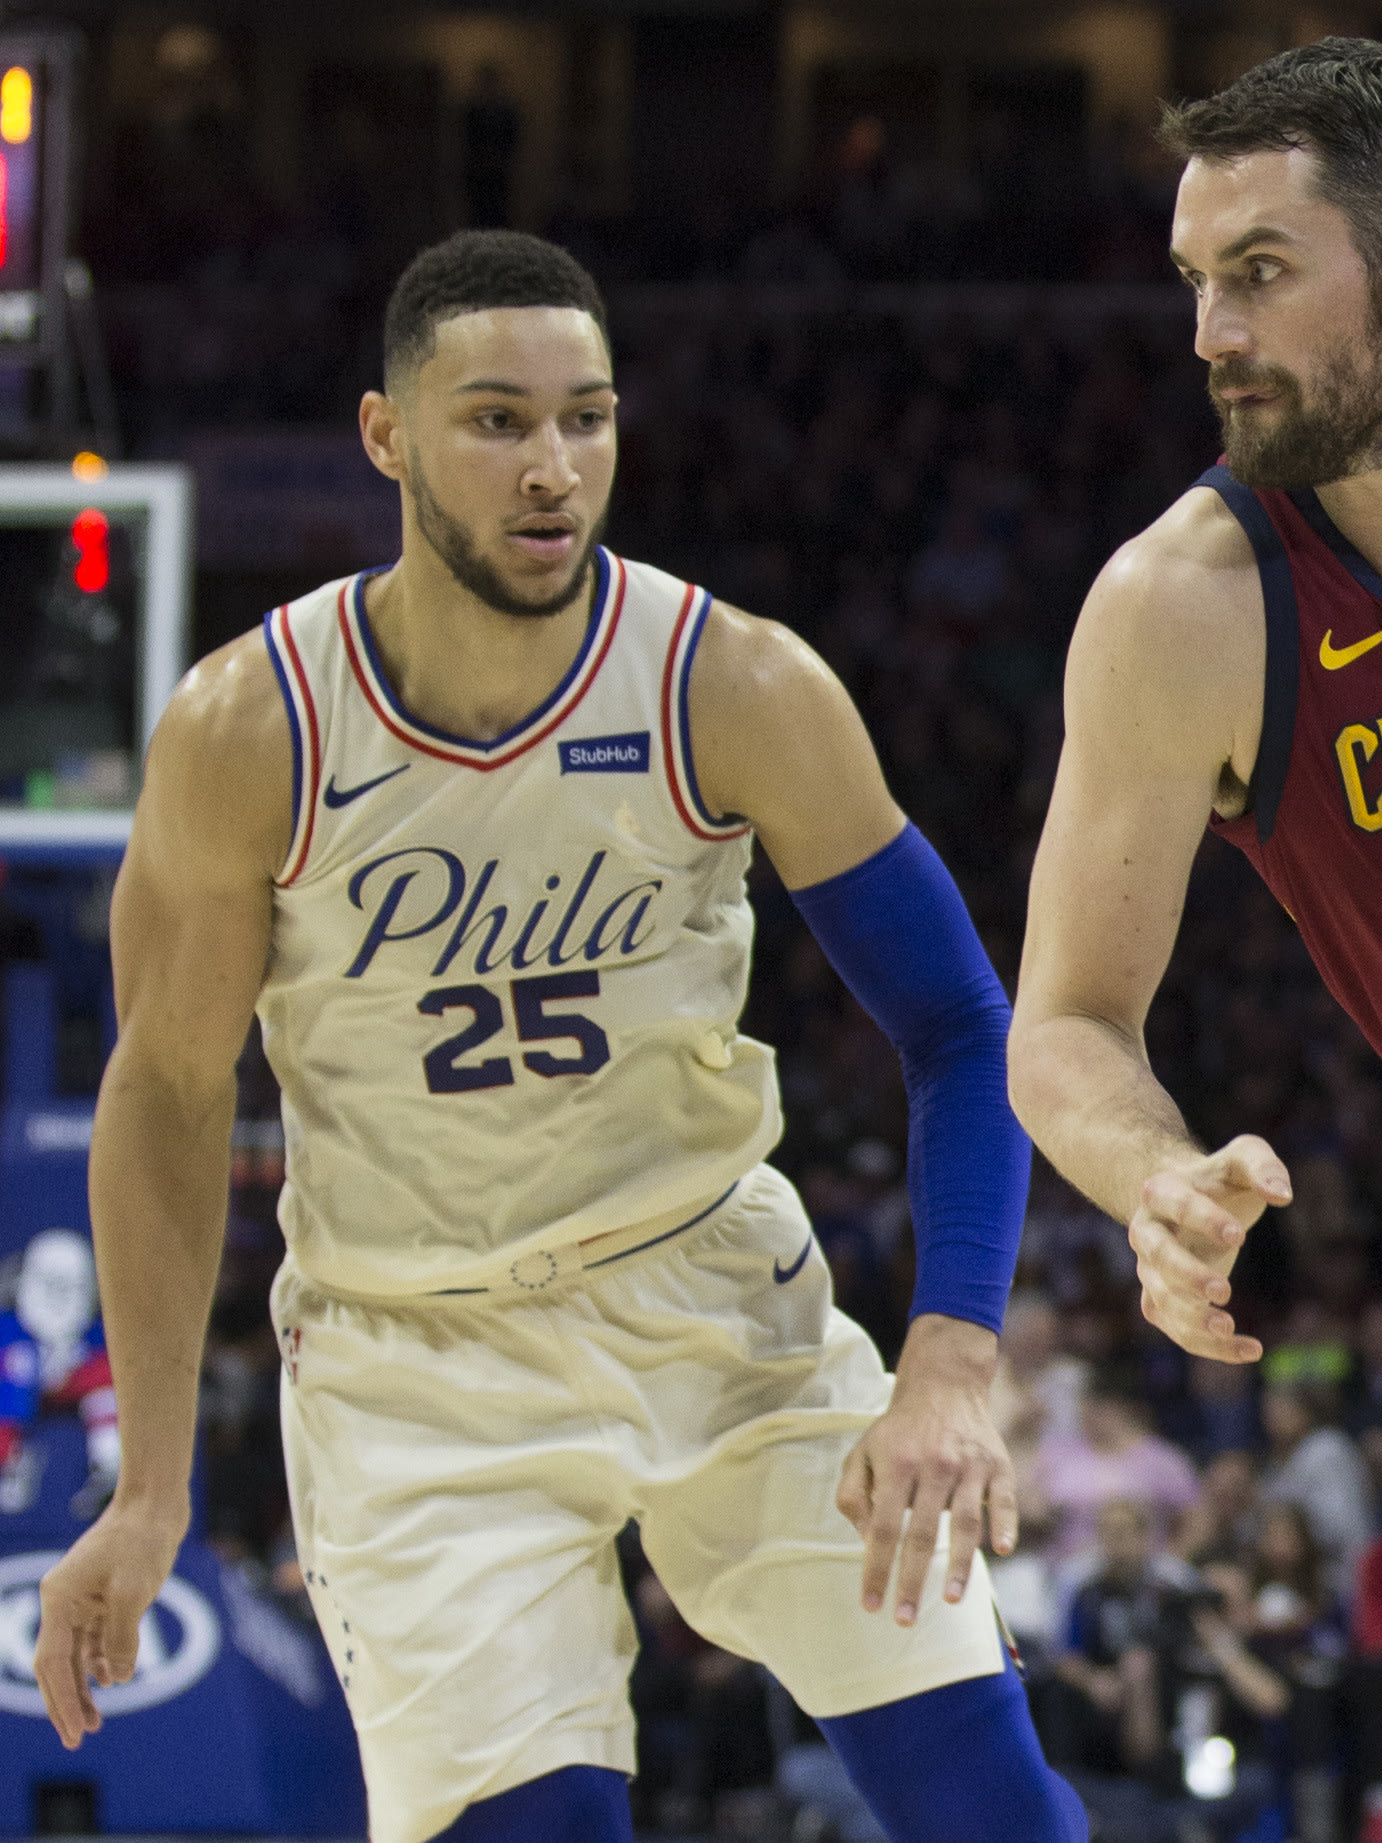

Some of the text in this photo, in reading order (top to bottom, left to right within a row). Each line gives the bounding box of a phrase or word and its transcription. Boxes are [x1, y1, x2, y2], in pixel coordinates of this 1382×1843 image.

[569, 745, 640, 765] StubHub
[343, 847, 662, 979] Phila
[416, 969, 611, 1094] 25
